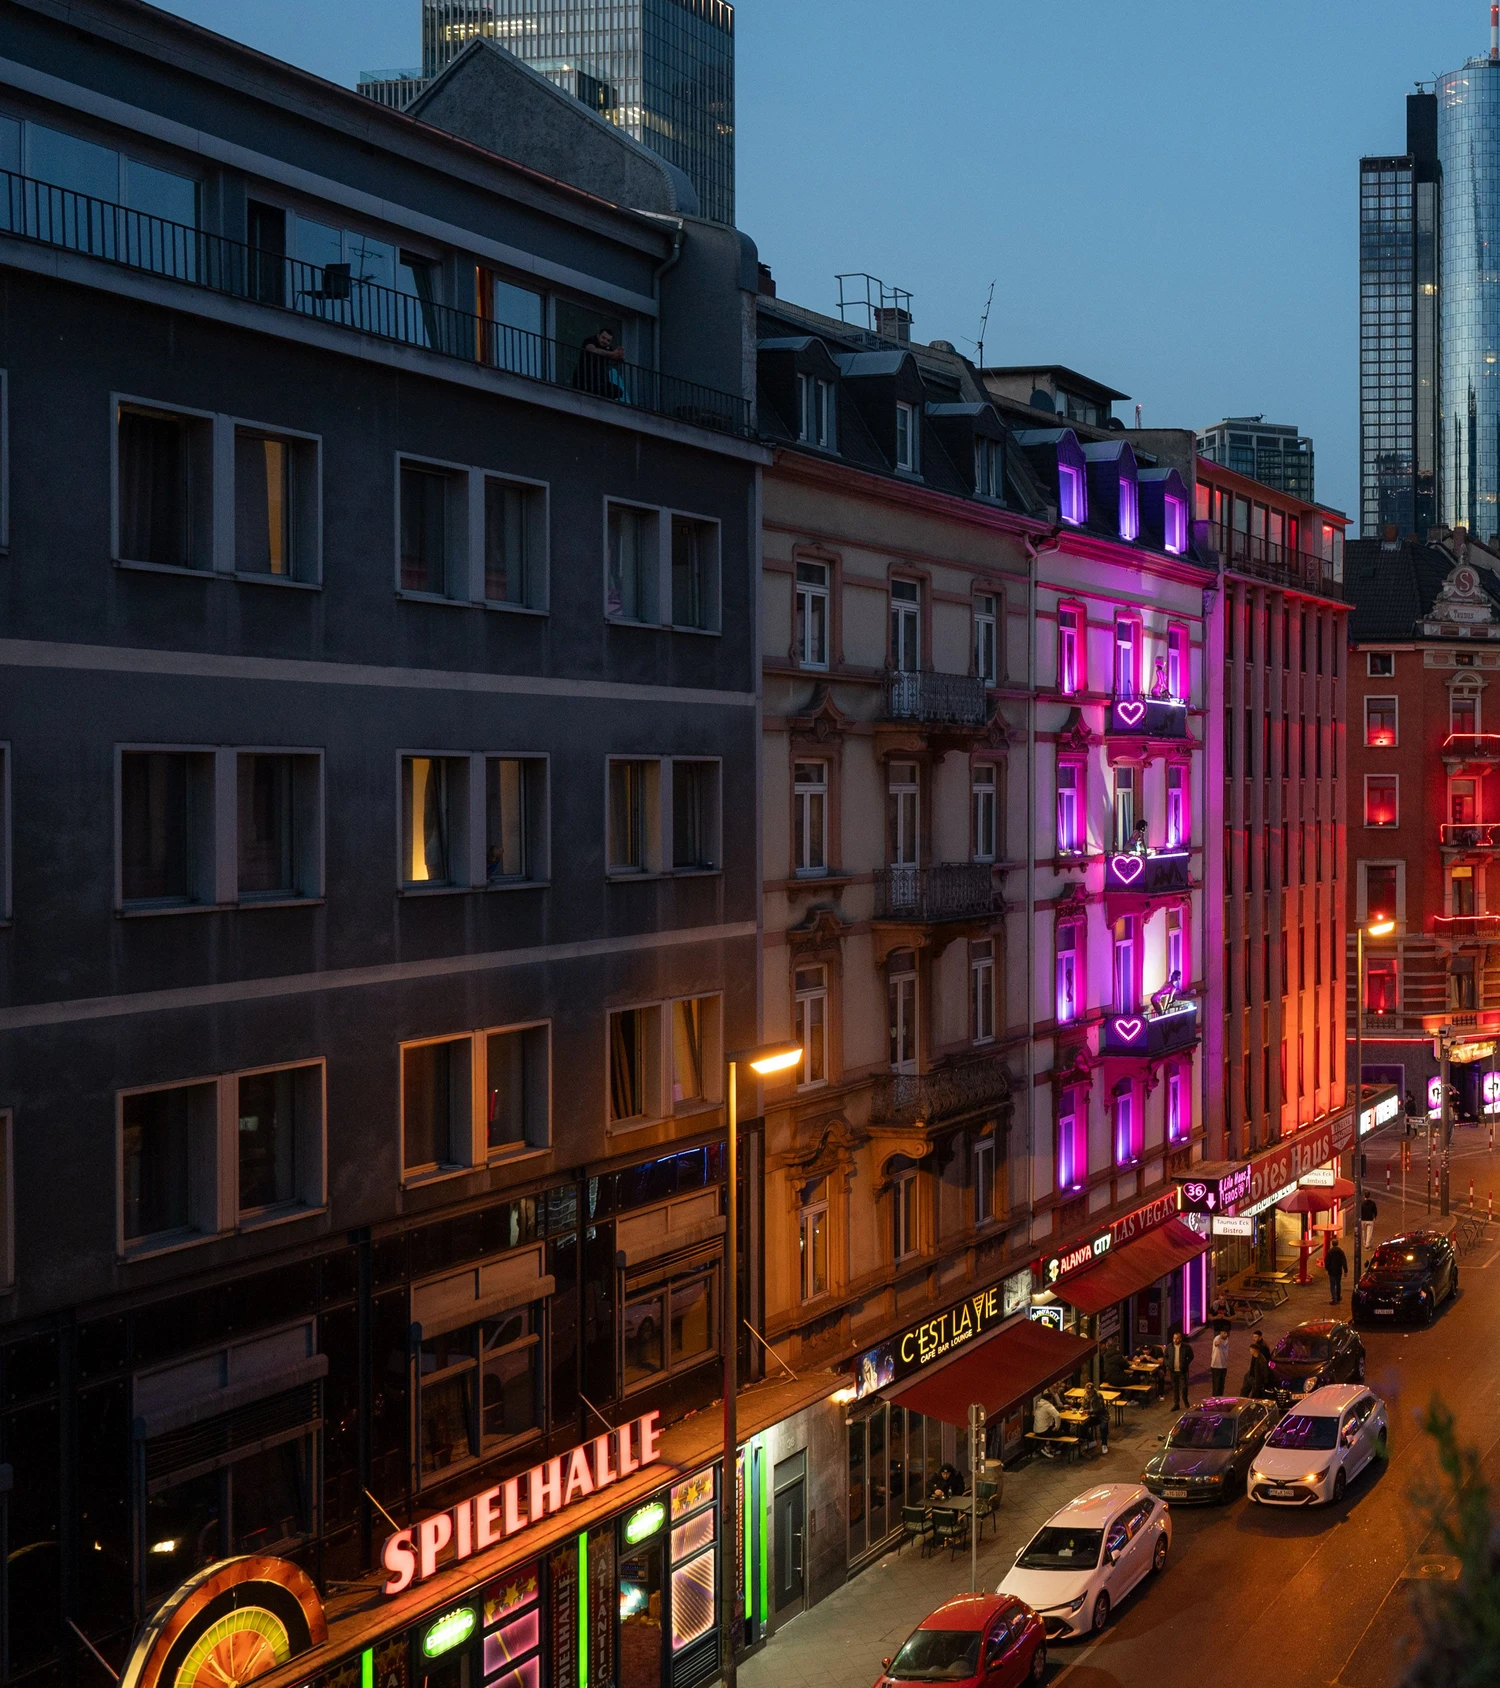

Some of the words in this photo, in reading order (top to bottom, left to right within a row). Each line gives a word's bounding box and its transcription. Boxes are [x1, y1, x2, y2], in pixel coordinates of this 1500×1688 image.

[1460, 572, 1469, 591] S
[1119, 861, 1137, 874] 36
[1234, 1171, 1247, 1185] Haus
[1239, 1158, 1287, 1208] otes
[1290, 1133, 1329, 1179] Haus
[1187, 1185, 1203, 1197] 36
[1225, 1188, 1238, 1205] EROS
[1113, 1217, 1135, 1244] LAS
[1138, 1193, 1176, 1228] VEGAS
[1060, 1244, 1092, 1274] ALANYA
[1094, 1233, 1111, 1256] CITY
[901, 1314, 948, 1363] C'EST
[952, 1304, 972, 1336] LA
[972, 1288, 998, 1333] VIE
[1049, 1310, 1060, 1323] CITY
[920, 1348, 936, 1364] CAFÉ
[938, 1343, 949, 1355] BAR
[950, 1328, 973, 1348] LOUNGE
[382, 1410, 661, 1595] SPIELHALLE
[597, 1558, 608, 1680] ATLANTIC
